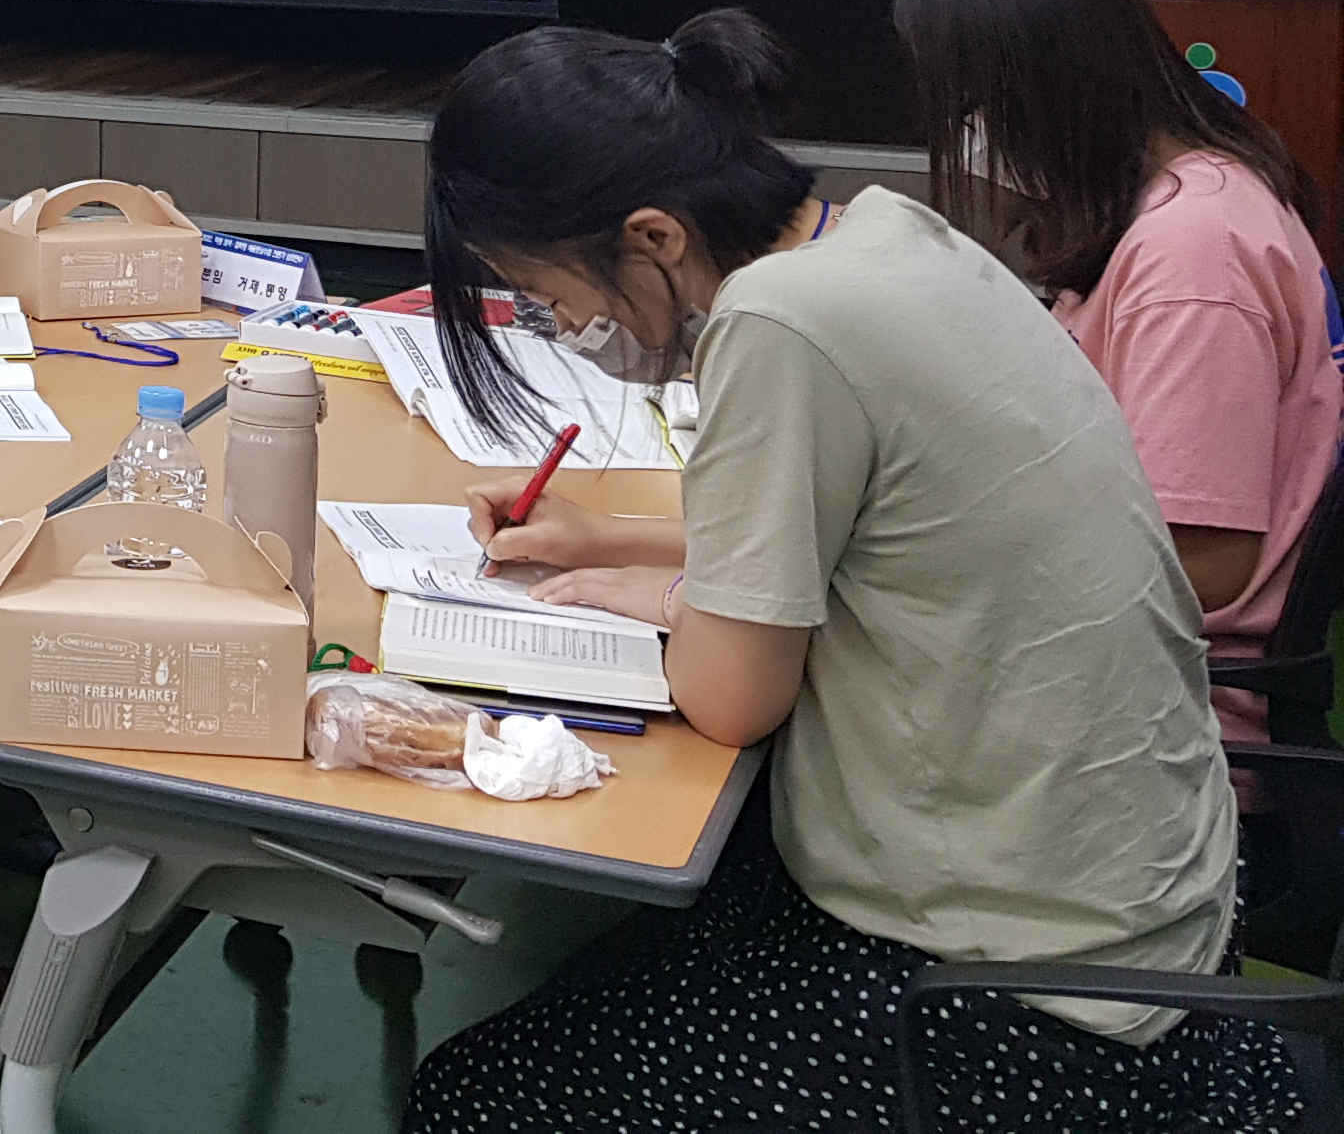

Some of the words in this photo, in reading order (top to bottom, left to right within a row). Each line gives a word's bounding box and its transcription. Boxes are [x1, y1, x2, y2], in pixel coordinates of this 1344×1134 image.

[84, 685, 123, 699] FRESH
[127, 687, 178, 702] MARKET
[84, 702, 123, 730] LOVE
